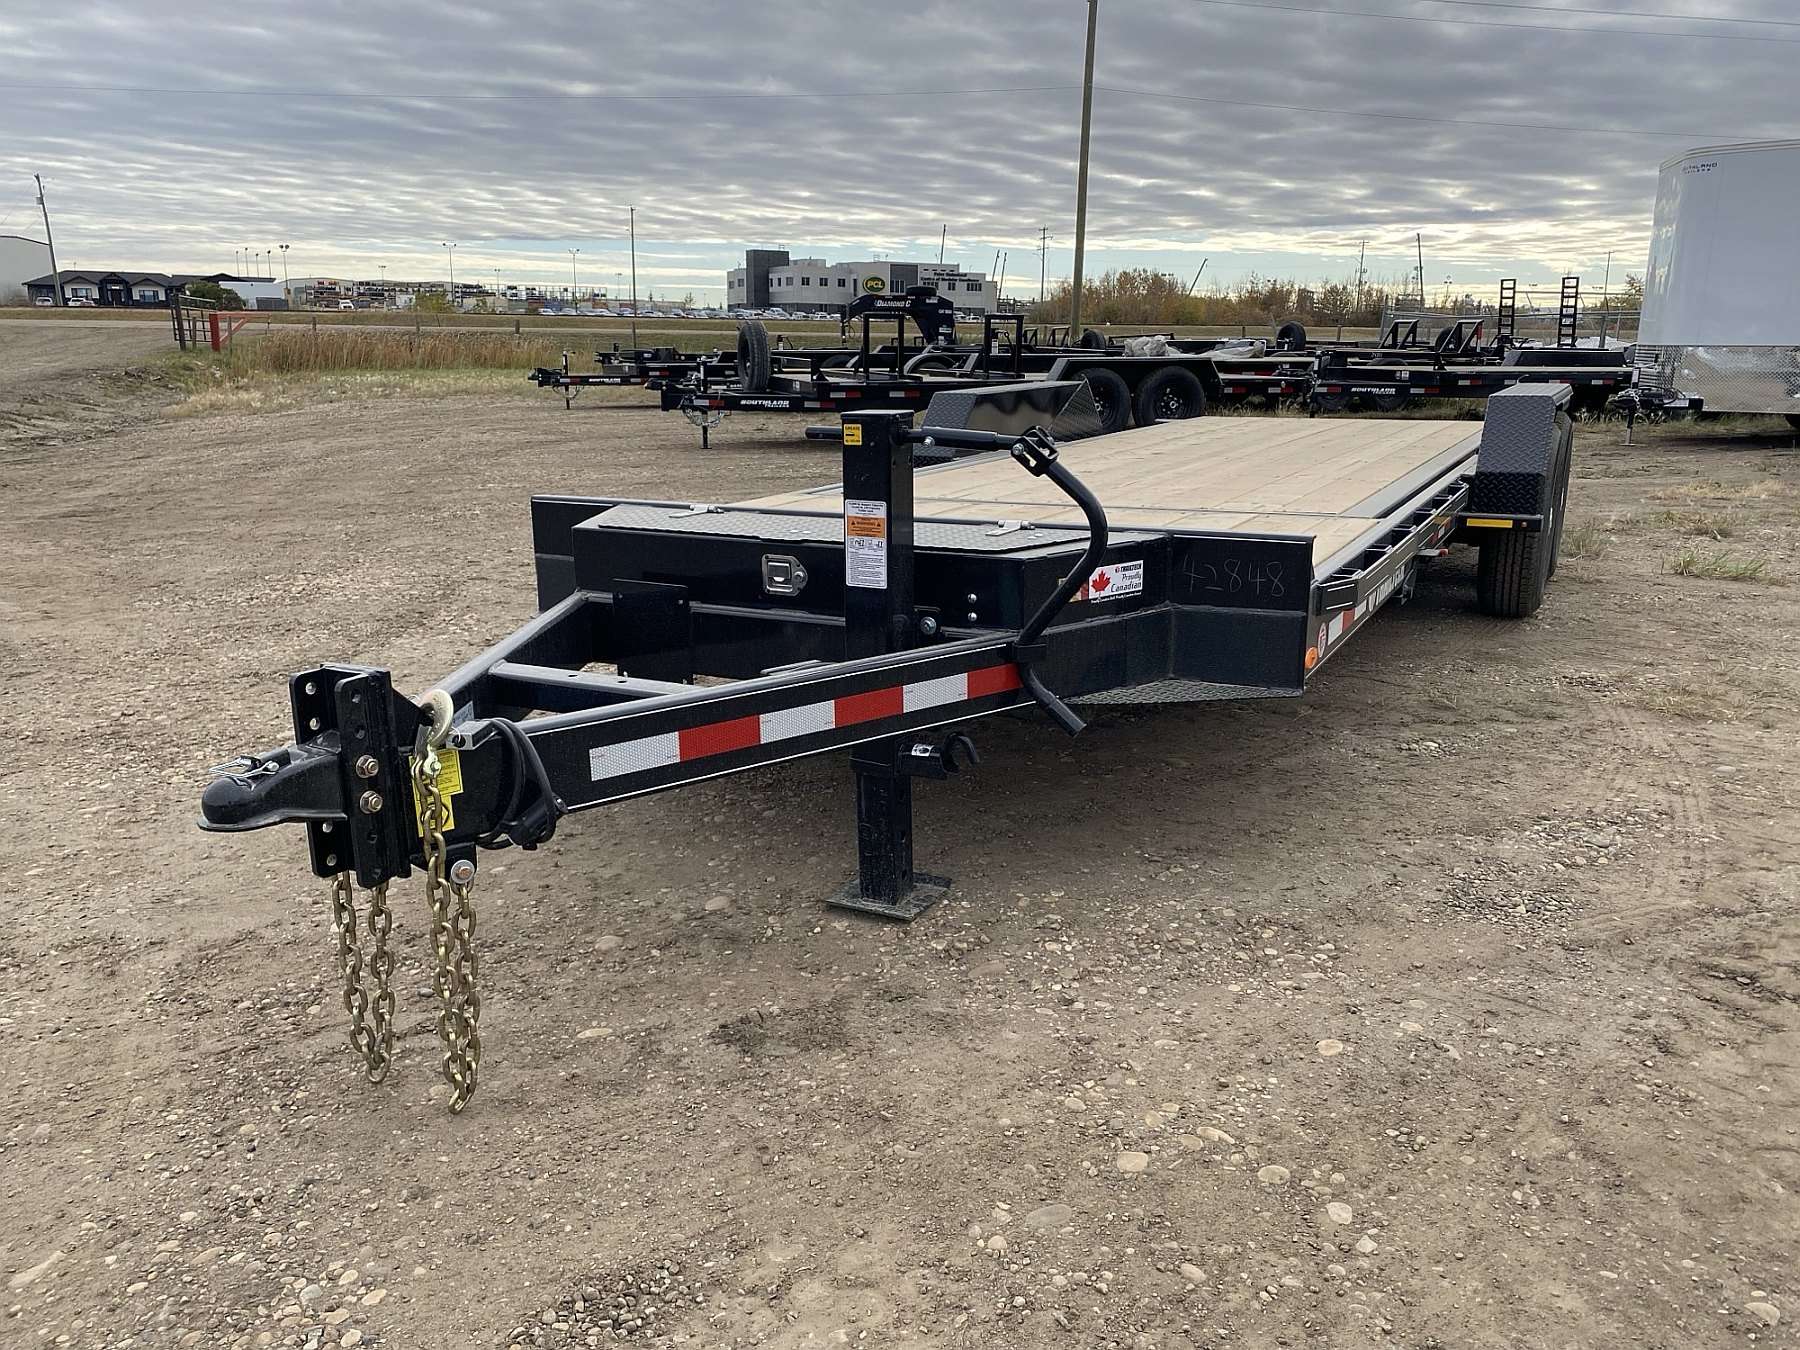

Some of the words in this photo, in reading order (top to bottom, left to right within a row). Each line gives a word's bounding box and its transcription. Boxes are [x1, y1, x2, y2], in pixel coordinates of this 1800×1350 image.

[867, 280, 884, 288] PCL
[1121, 571, 1142, 582] Proudly
[1182, 552, 1287, 598] 42848
[1110, 581, 1142, 593] Canadian
